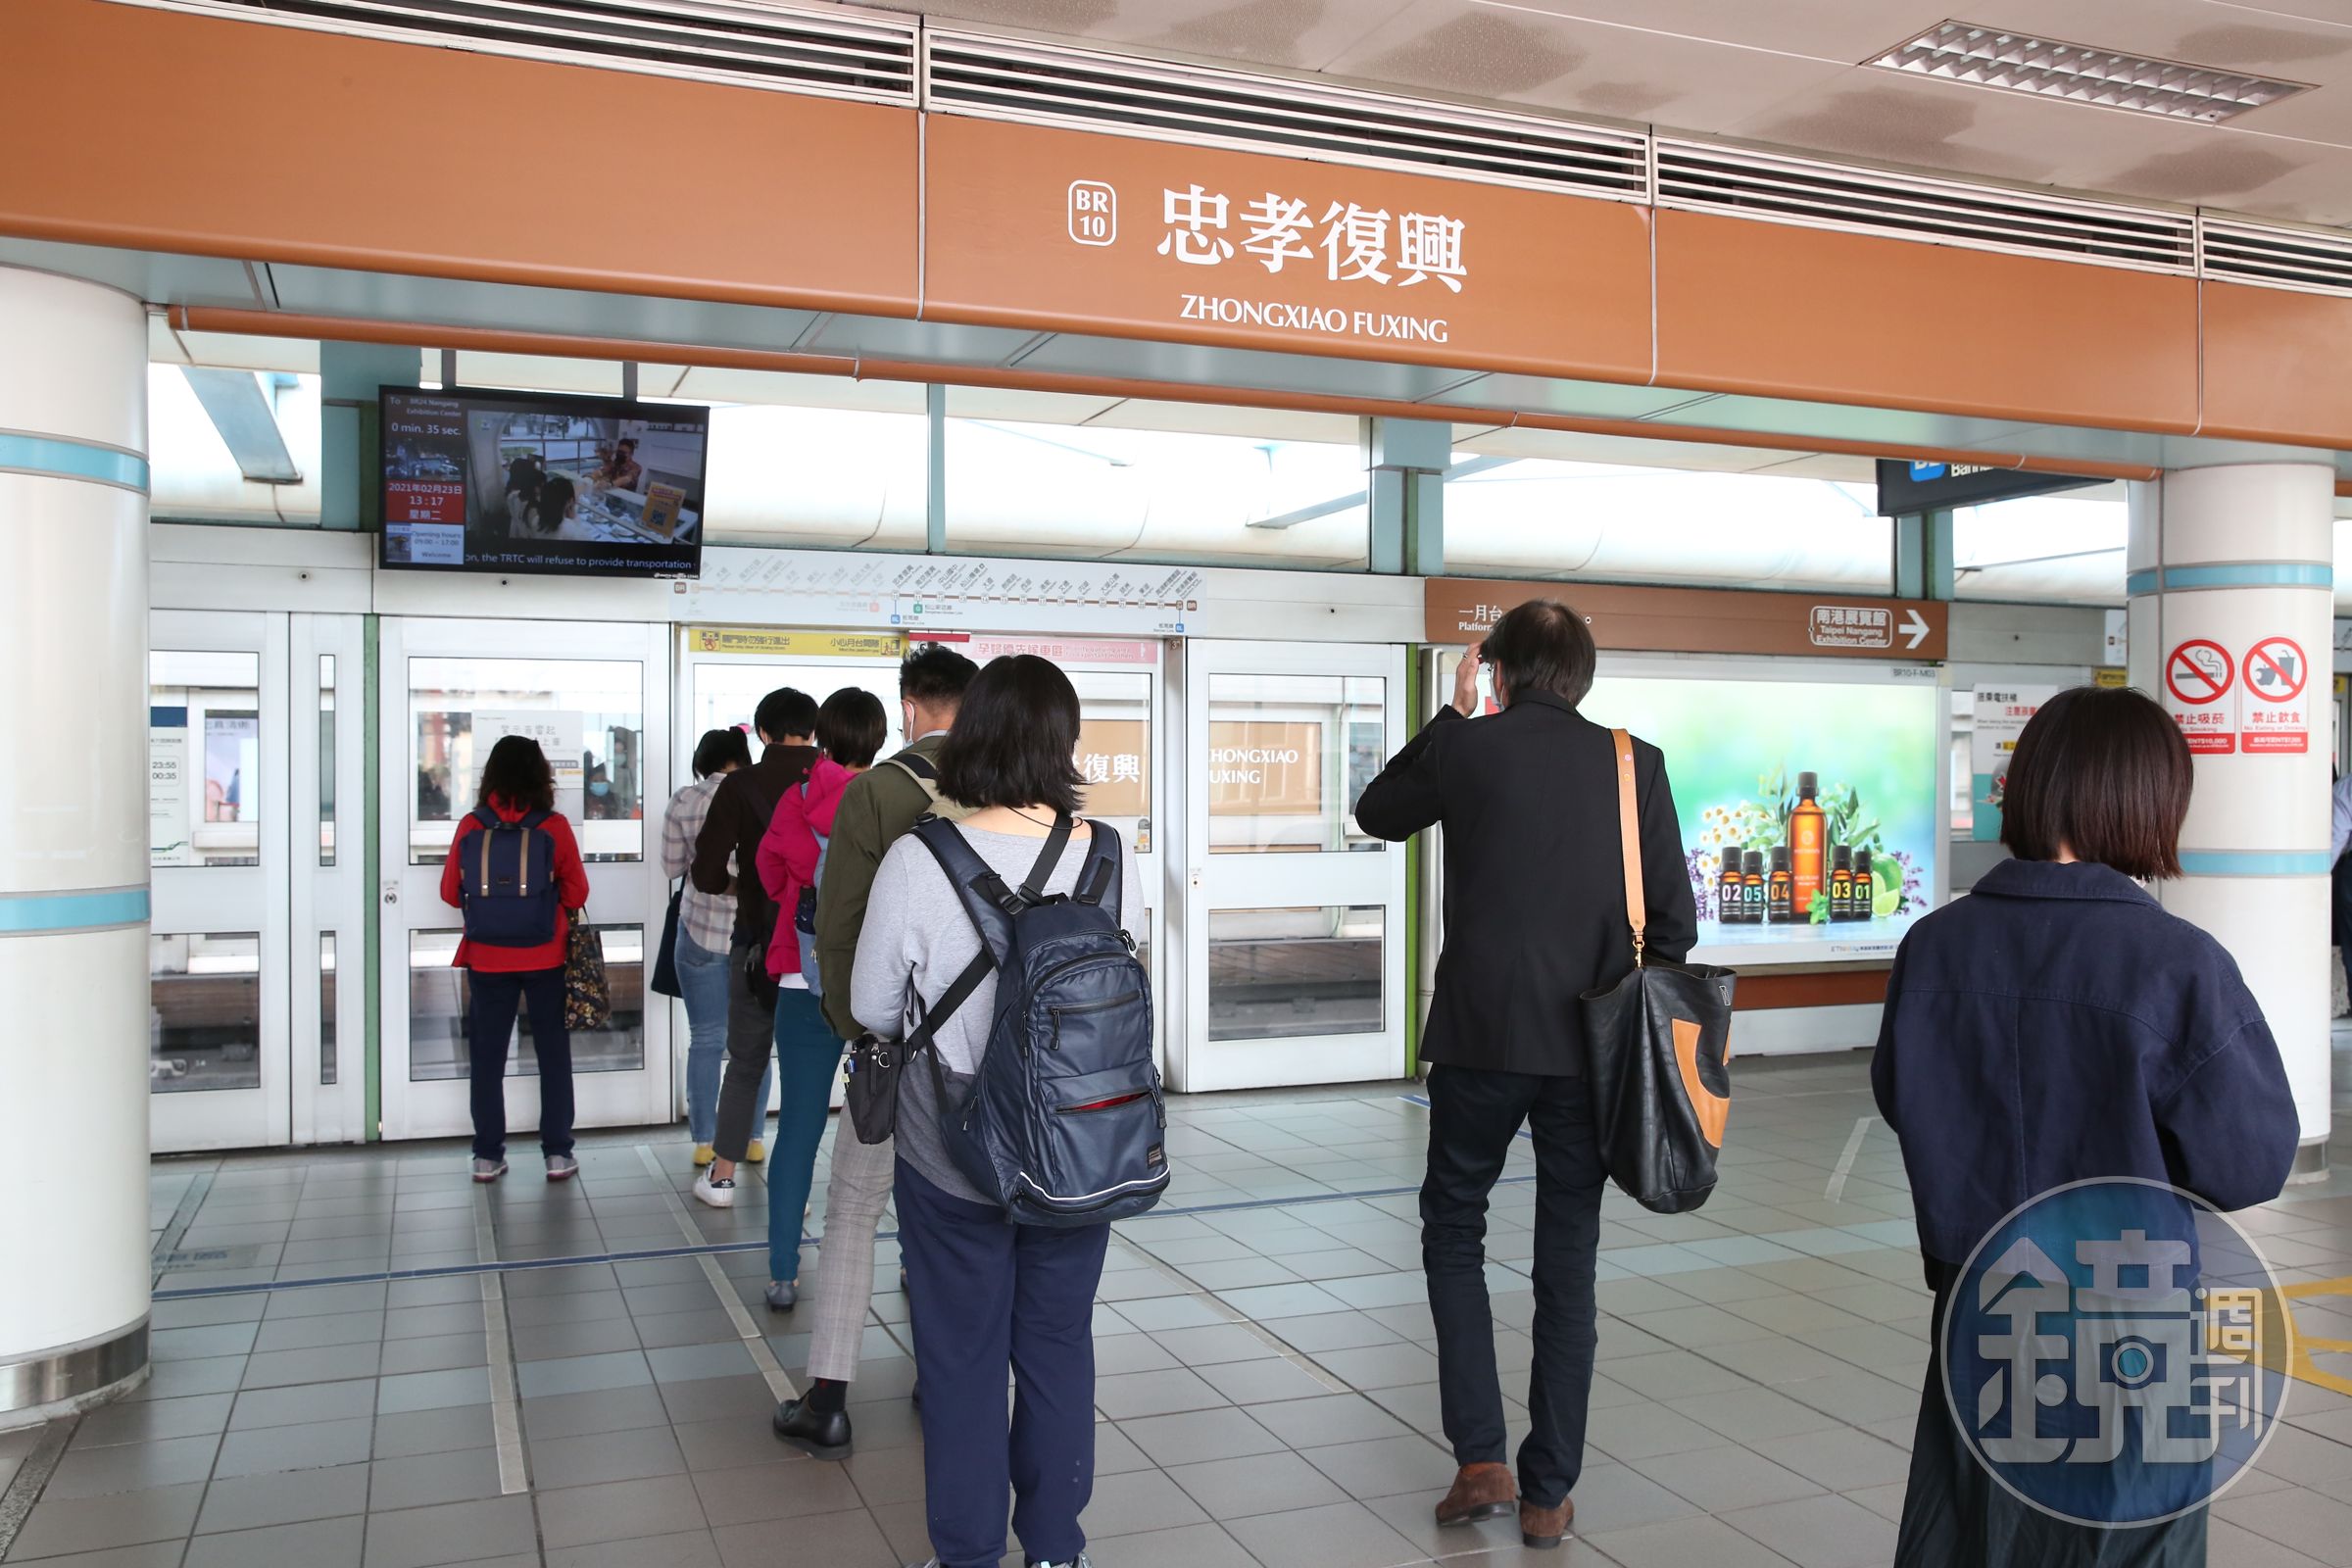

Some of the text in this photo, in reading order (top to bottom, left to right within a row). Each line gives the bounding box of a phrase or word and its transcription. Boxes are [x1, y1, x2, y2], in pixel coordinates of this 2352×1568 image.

[1076, 189, 1108, 214] BR
[1080, 215, 1106, 238] 10
[1156, 183, 1468, 293] 忠孝復興
[1179, 294, 1448, 343] ZHONGXIAO FUXING
[426, 424, 440, 434] 35
[481, 554, 498, 563] the
[500, 554, 525, 564] TRTC
[526, 555, 544, 564] will
[545, 555, 574, 565] refuse
[576, 557, 587, 565] to
[588, 557, 623, 568] provide
[626, 560, 692, 570] transportation
[1816, 609, 1887, 626] 南港展覽館
[1816, 634, 1858, 645] Exhibition
[1820, 625, 1884, 637] Taipei Nangang
[1208, 748, 1298, 765] HONGXIAO
[1071, 752, 1141, 784] 復興
[1208, 769, 1261, 784] UXING
[1722, 884, 1741, 901] 02
[1743, 887, 1762, 902] 05
[1771, 884, 1789, 901] 04
[1832, 882, 1851, 899] 03
[1855, 885, 1870, 900] 01
